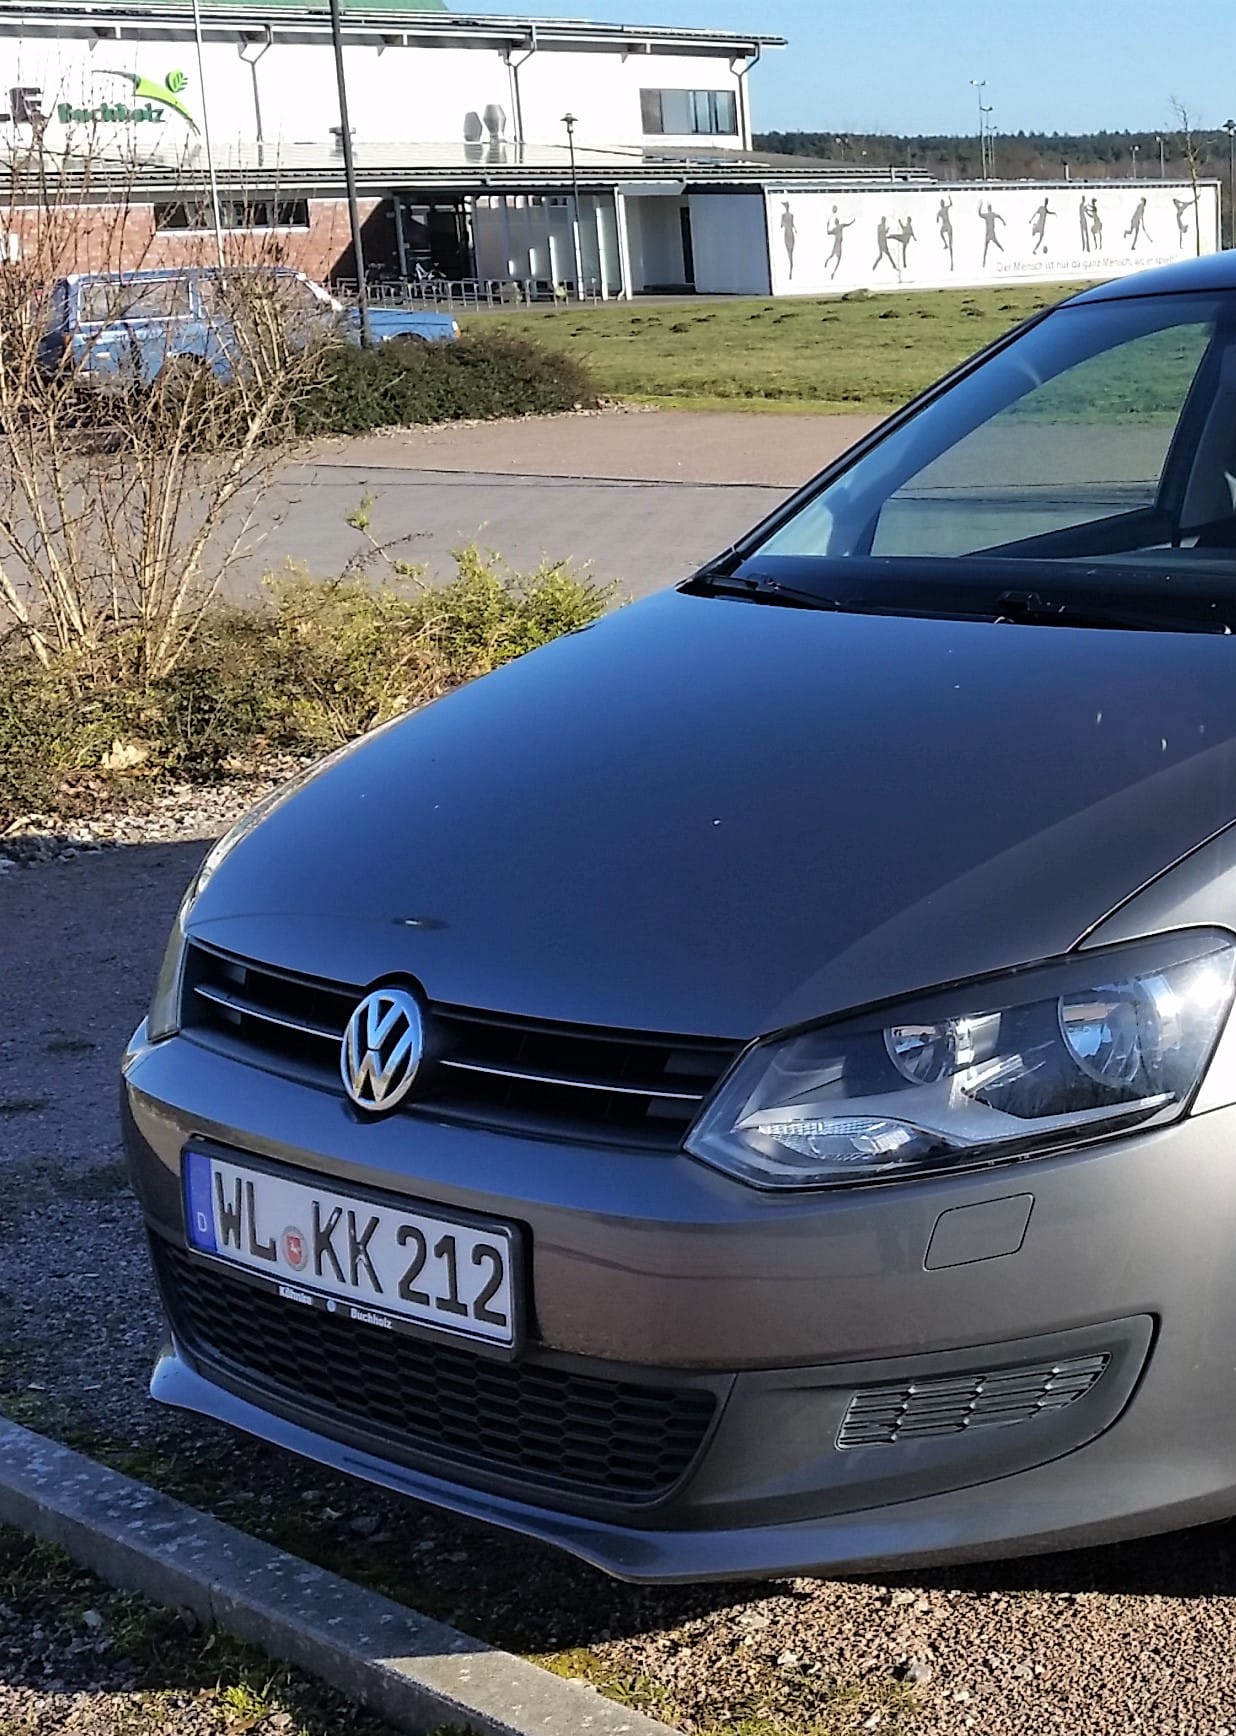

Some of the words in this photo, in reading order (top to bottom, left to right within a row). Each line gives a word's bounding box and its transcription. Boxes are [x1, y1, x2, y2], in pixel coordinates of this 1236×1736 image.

[57, 102, 167, 124] Buchholz
[196, 1212, 208, 1233] D
[214, 1172, 278, 1262] WL
[311, 1200, 384, 1294] KK
[396, 1224, 508, 1327] 212
[350, 1307, 393, 1330] Buchholz
